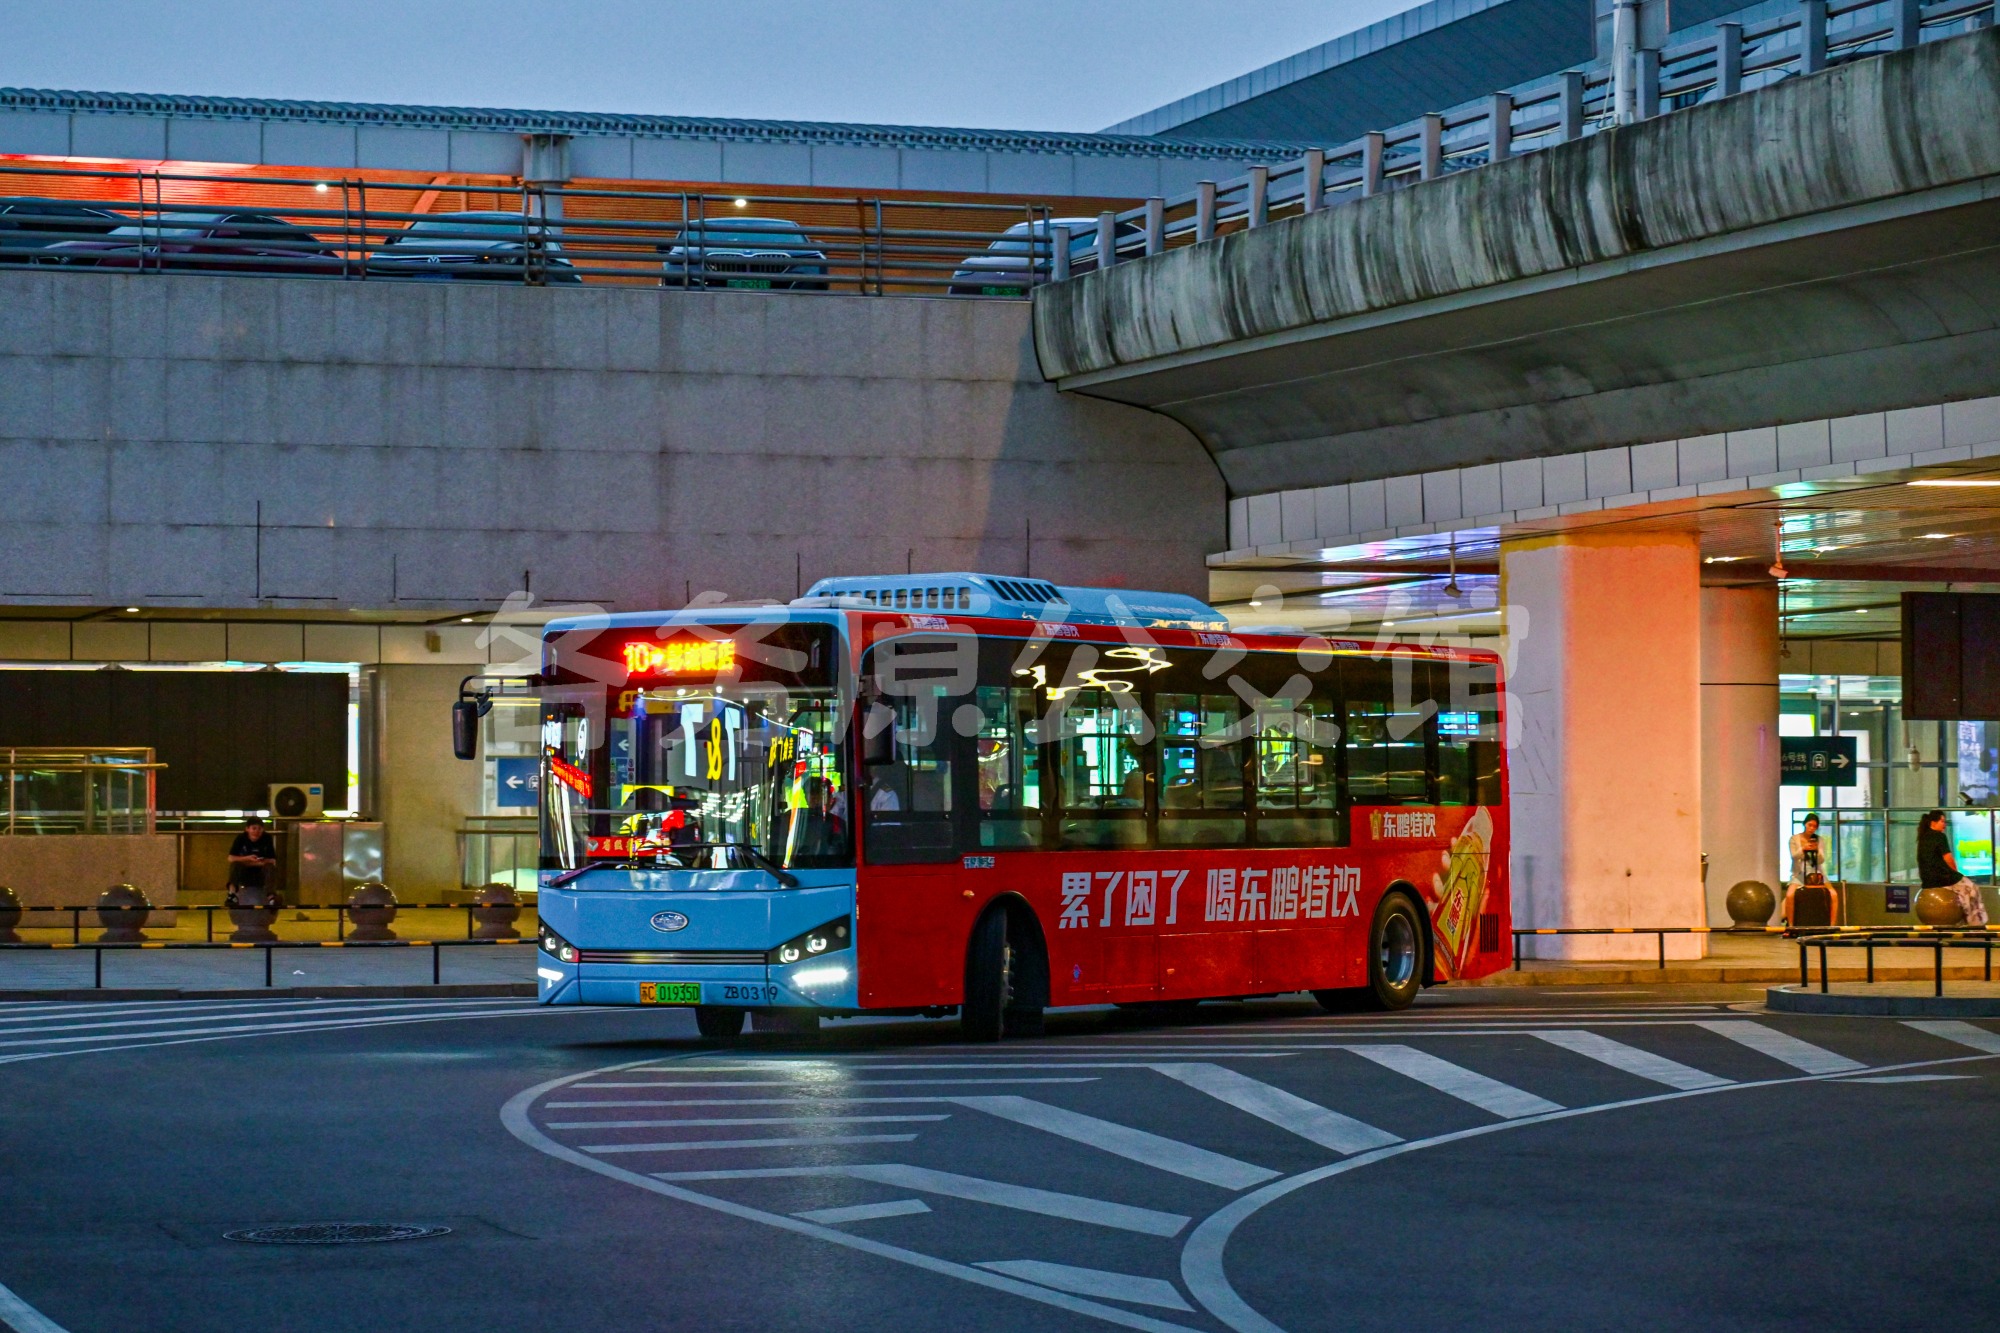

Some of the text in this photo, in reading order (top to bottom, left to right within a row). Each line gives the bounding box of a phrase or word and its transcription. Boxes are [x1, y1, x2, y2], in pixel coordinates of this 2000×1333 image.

[623, 644, 649, 672] 10
[1383, 811, 1437, 838] 东鹏特饮
[1058, 864, 1361, 929] 累了困了 喝东鹏特饮
[723, 986, 778, 1000] ZB0319
